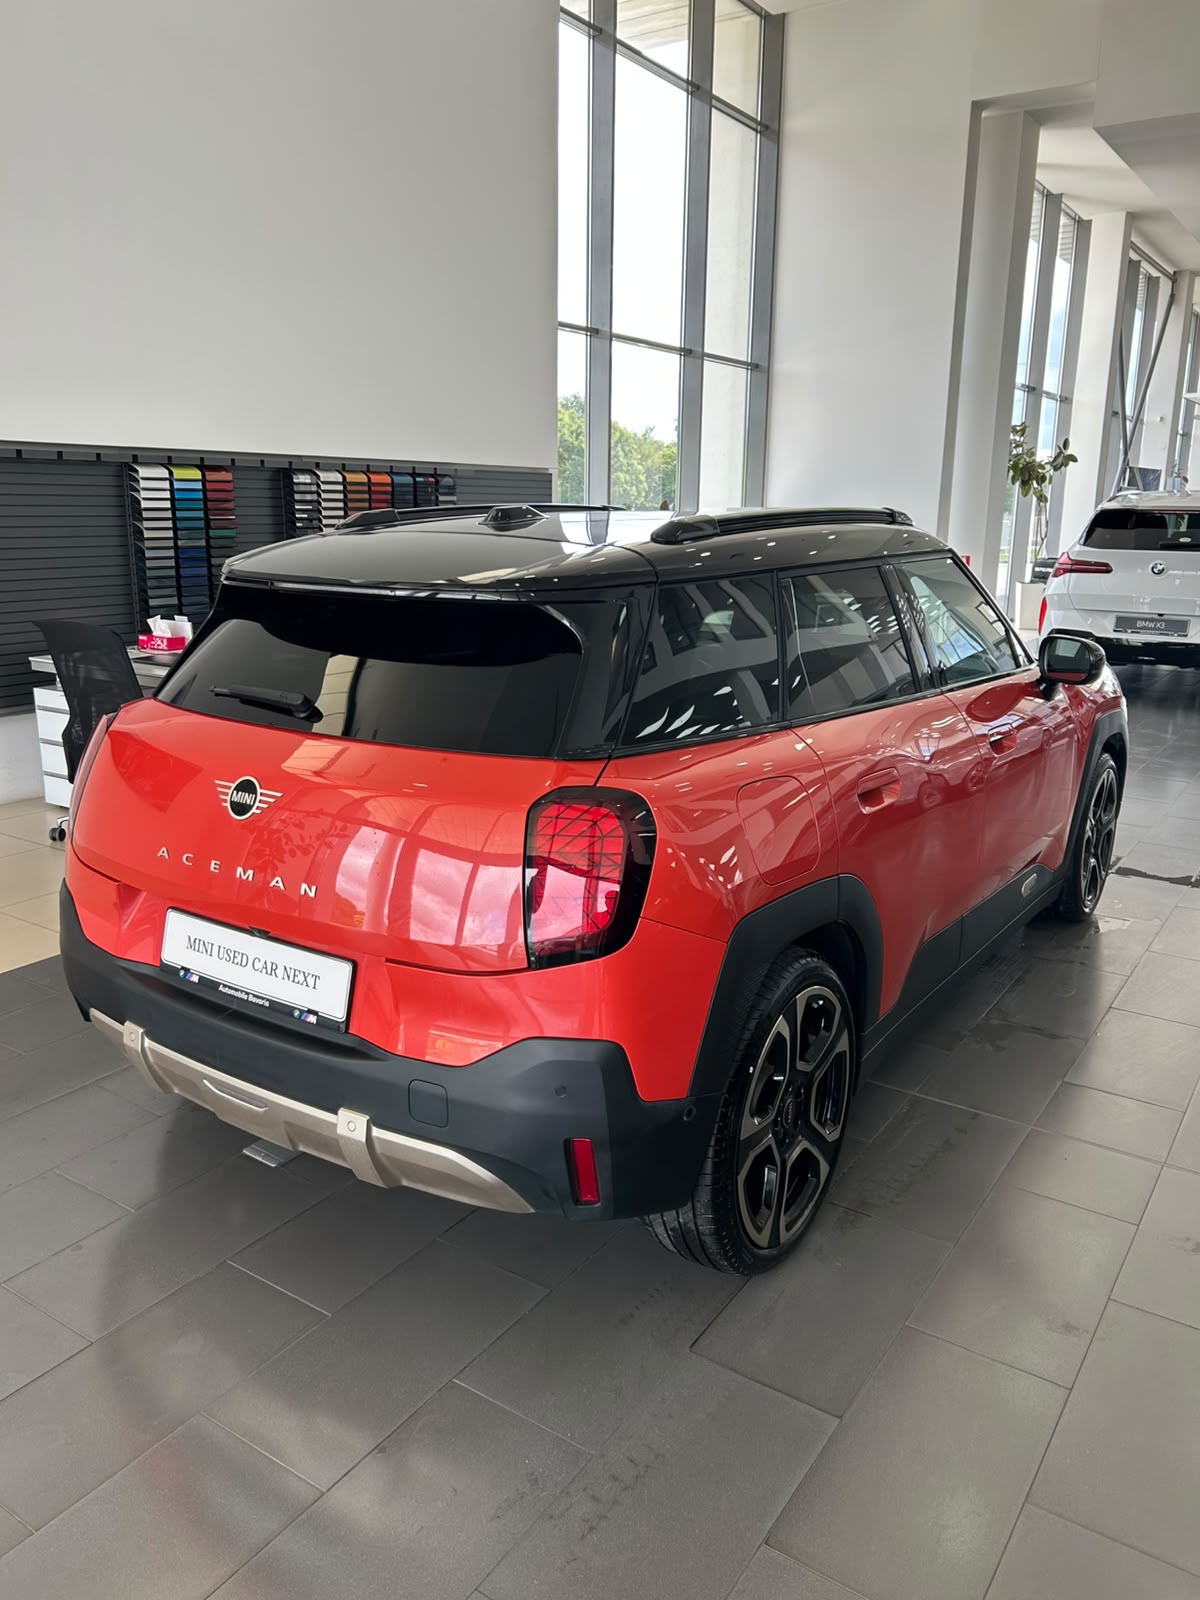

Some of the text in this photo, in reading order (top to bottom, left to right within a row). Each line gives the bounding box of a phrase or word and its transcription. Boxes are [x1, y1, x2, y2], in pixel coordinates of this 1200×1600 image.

[1136, 620, 1166, 629] BMW X3
[231, 790, 255, 805] MINI
[157, 846, 318, 898] ACEMAN
[186, 935, 320, 990] MINI USED CAR NEXT
[218, 984, 270, 1007] Automobile Bavaria
